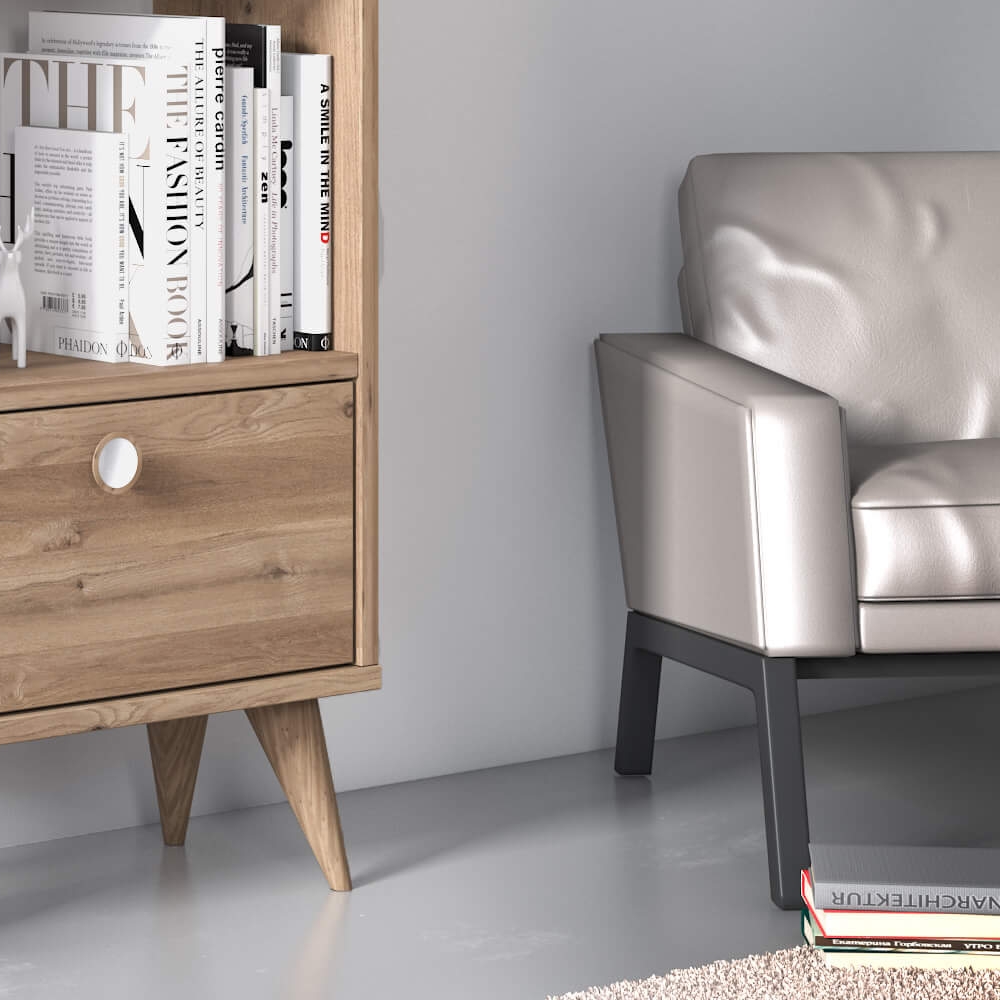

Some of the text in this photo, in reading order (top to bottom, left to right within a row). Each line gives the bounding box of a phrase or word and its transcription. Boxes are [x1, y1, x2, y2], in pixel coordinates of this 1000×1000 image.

[320, 83, 330, 94] A
[212, 48, 225, 171] pierre cardin
[320, 98, 330, 145] SMILE
[194, 40, 204, 230] THE ALLURE OF BEAUTY
[320, 150, 330, 165] IN
[261, 171, 269, 204] zen
[320, 169, 330, 198] THE
[166, 65, 188, 361] THE FASHION BOOK
[320, 203, 330, 244] MIND
[270, 221, 278, 274] Photographs
[57, 336, 109, 356] PHAIDON
[831, 938, 891, 948] Екатерина
[893, 940, 952, 949] Горбовская
[963, 943, 993, 951] УТРО
